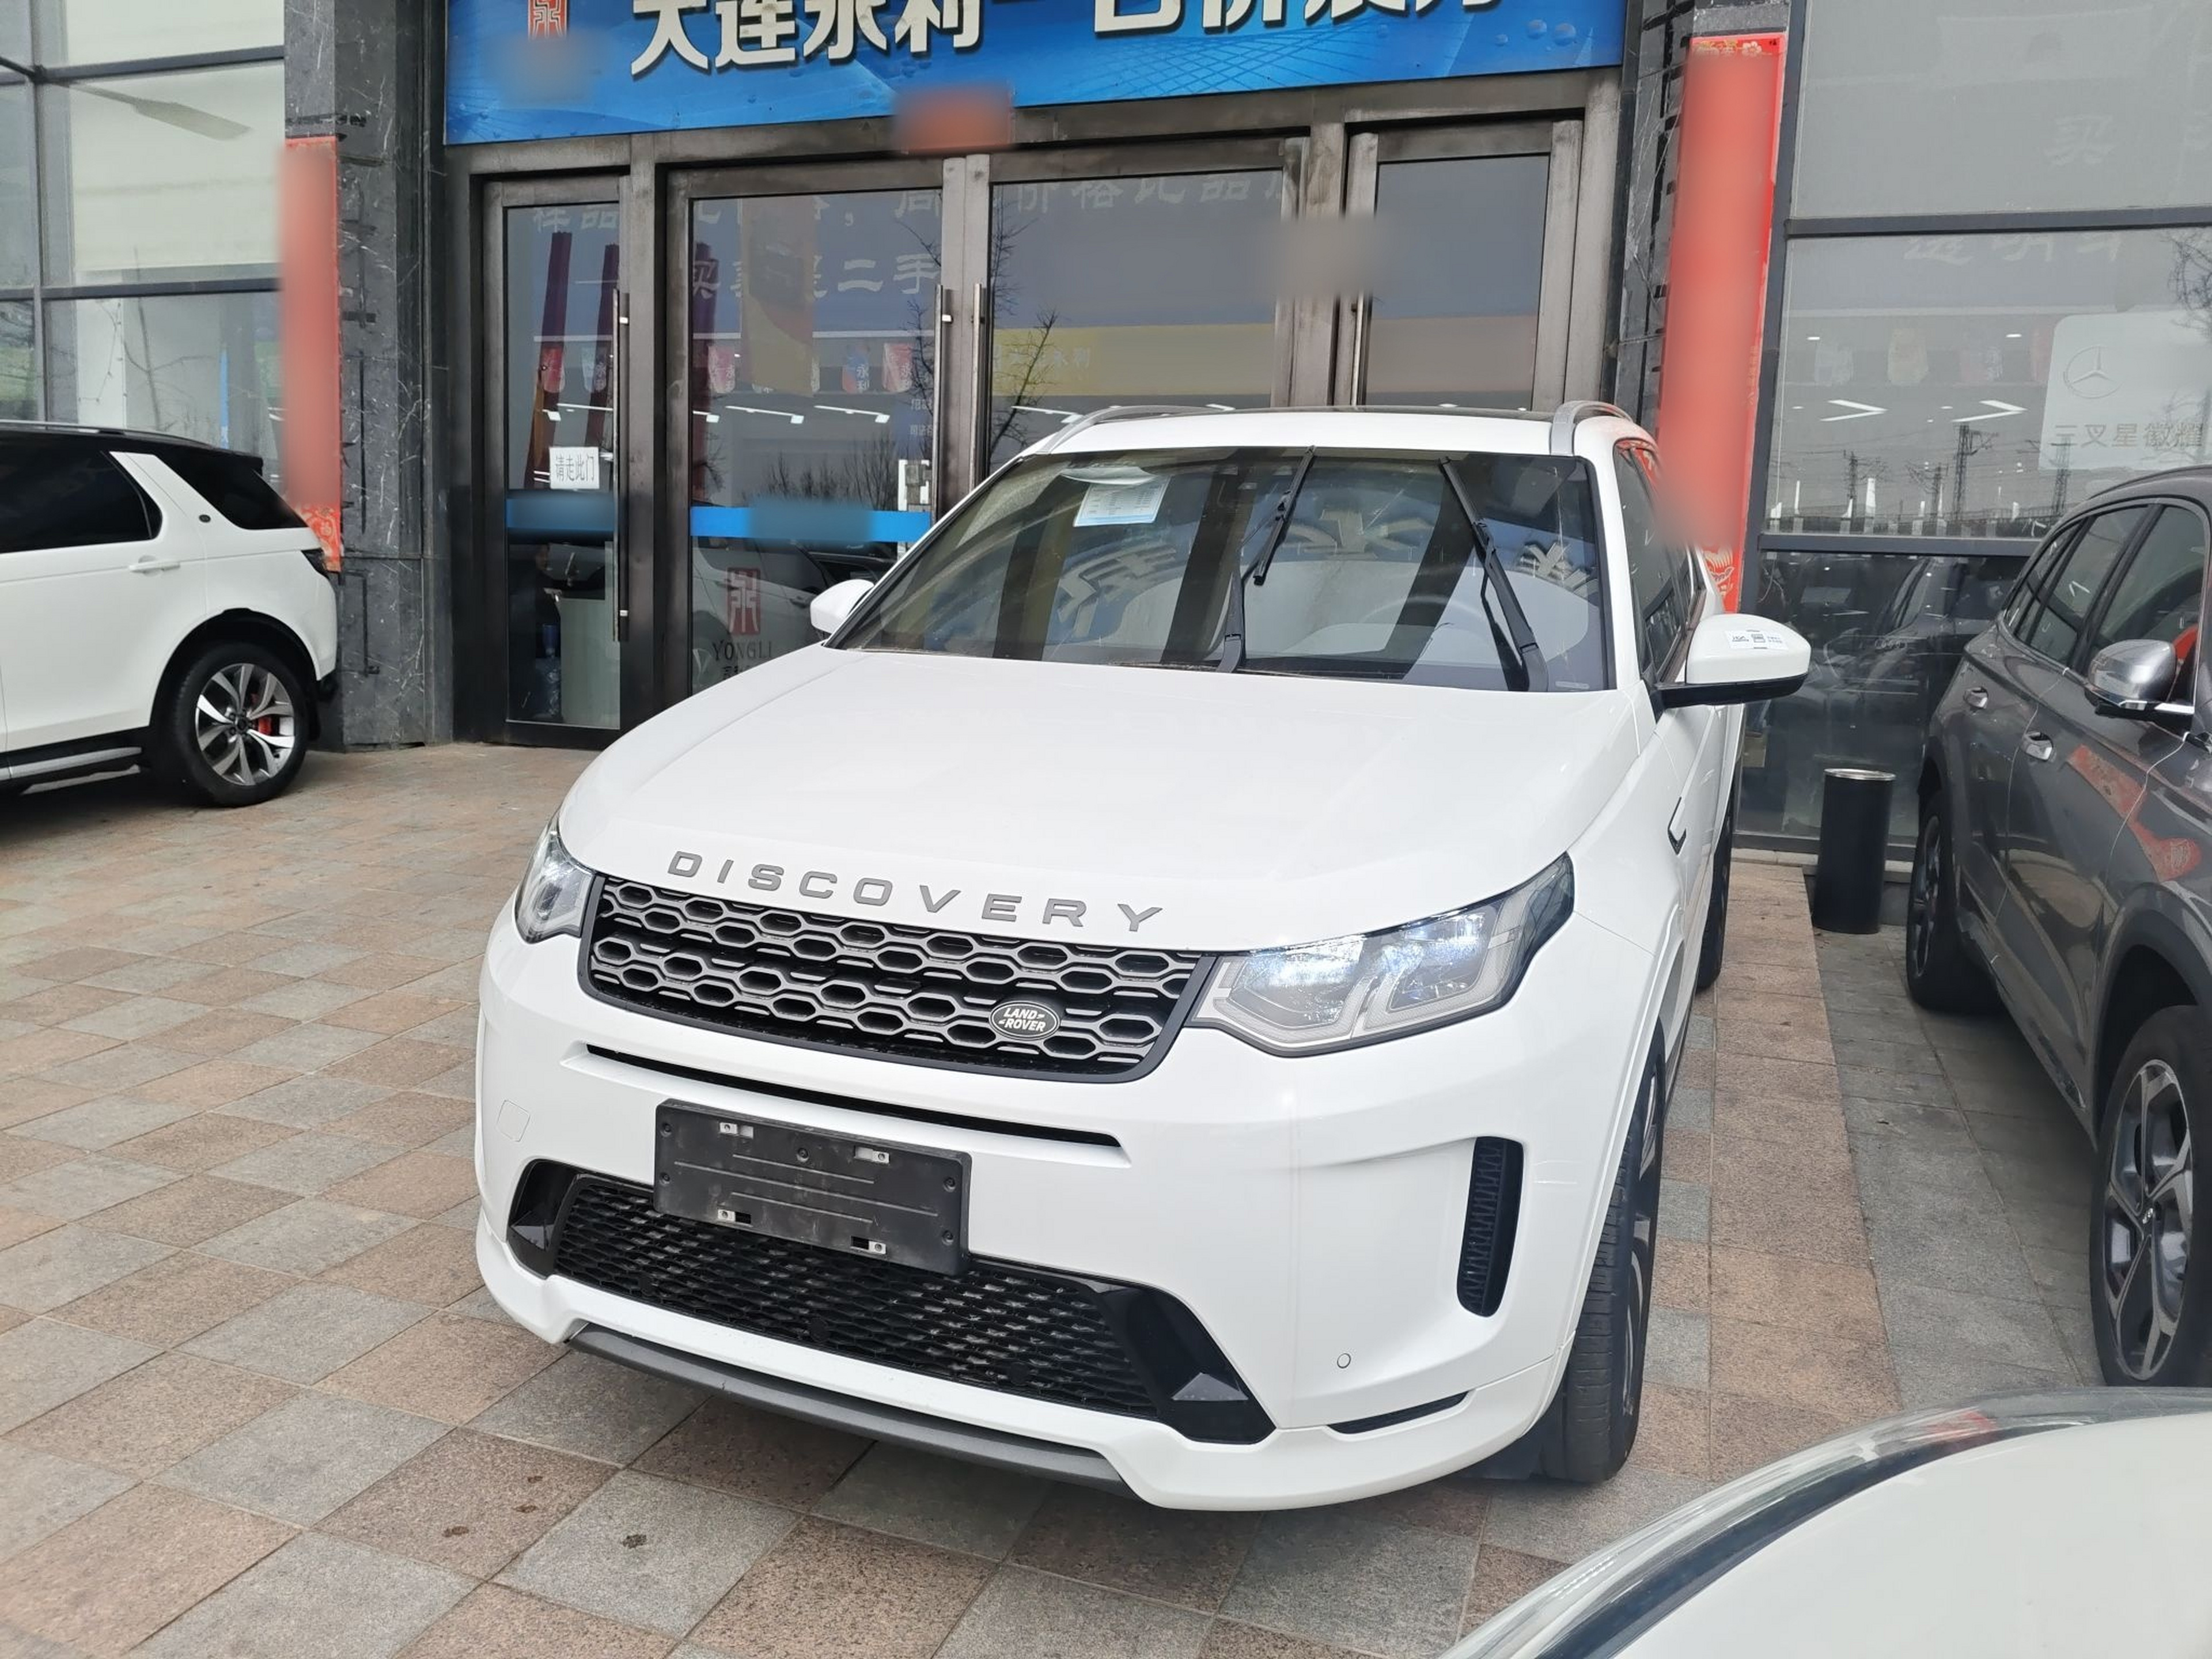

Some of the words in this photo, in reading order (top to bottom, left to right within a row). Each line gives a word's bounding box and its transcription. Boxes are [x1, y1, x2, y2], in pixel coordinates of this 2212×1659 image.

[555, 453, 595, 482] 请走此门
[712, 639, 772, 662] YONGLI
[668, 850, 1162, 932] DISCOVERY
[1003, 1007, 1038, 1020] LAND
[1004, 1018, 1046, 1032] ROVER
